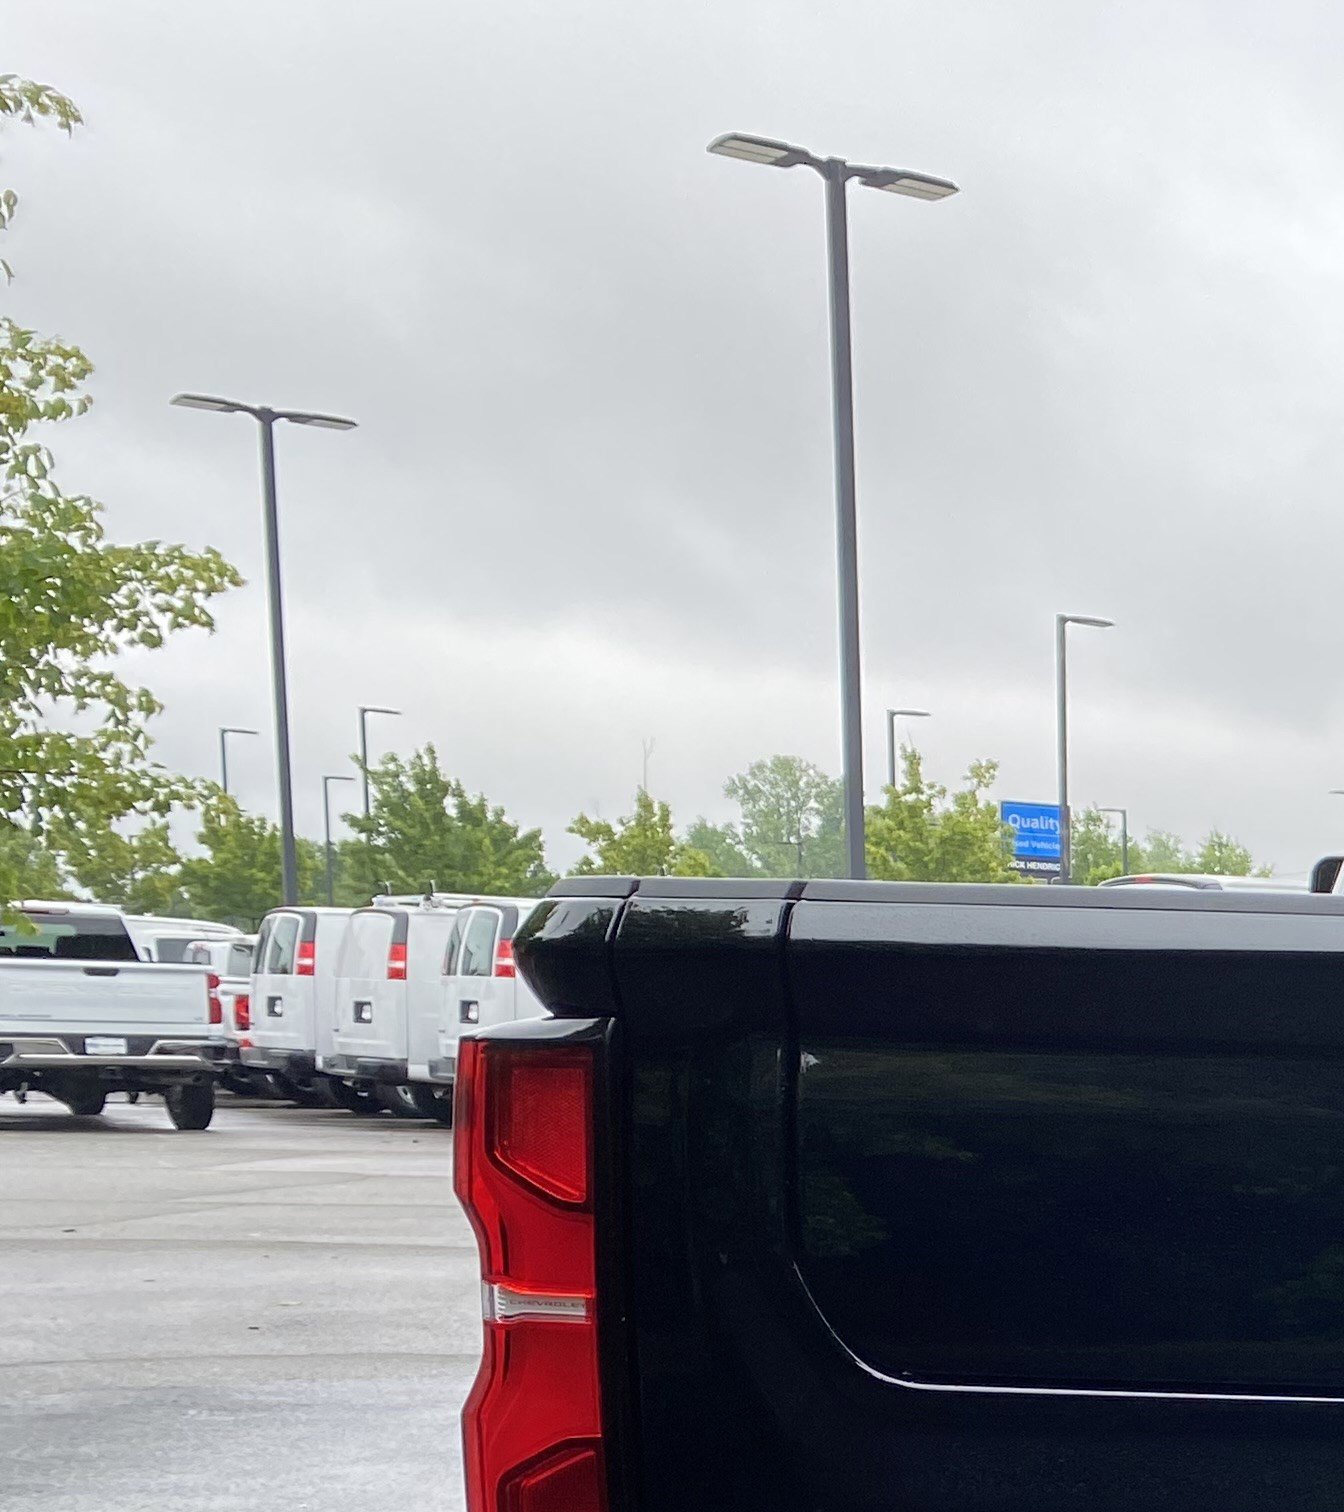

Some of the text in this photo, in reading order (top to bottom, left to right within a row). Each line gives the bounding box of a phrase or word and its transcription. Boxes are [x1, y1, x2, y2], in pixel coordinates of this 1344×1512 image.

[1008, 813, 1060, 835] Quality
[1031, 840, 1061, 851] Vehicle
[1027, 861, 1061, 872] HENDRIC
